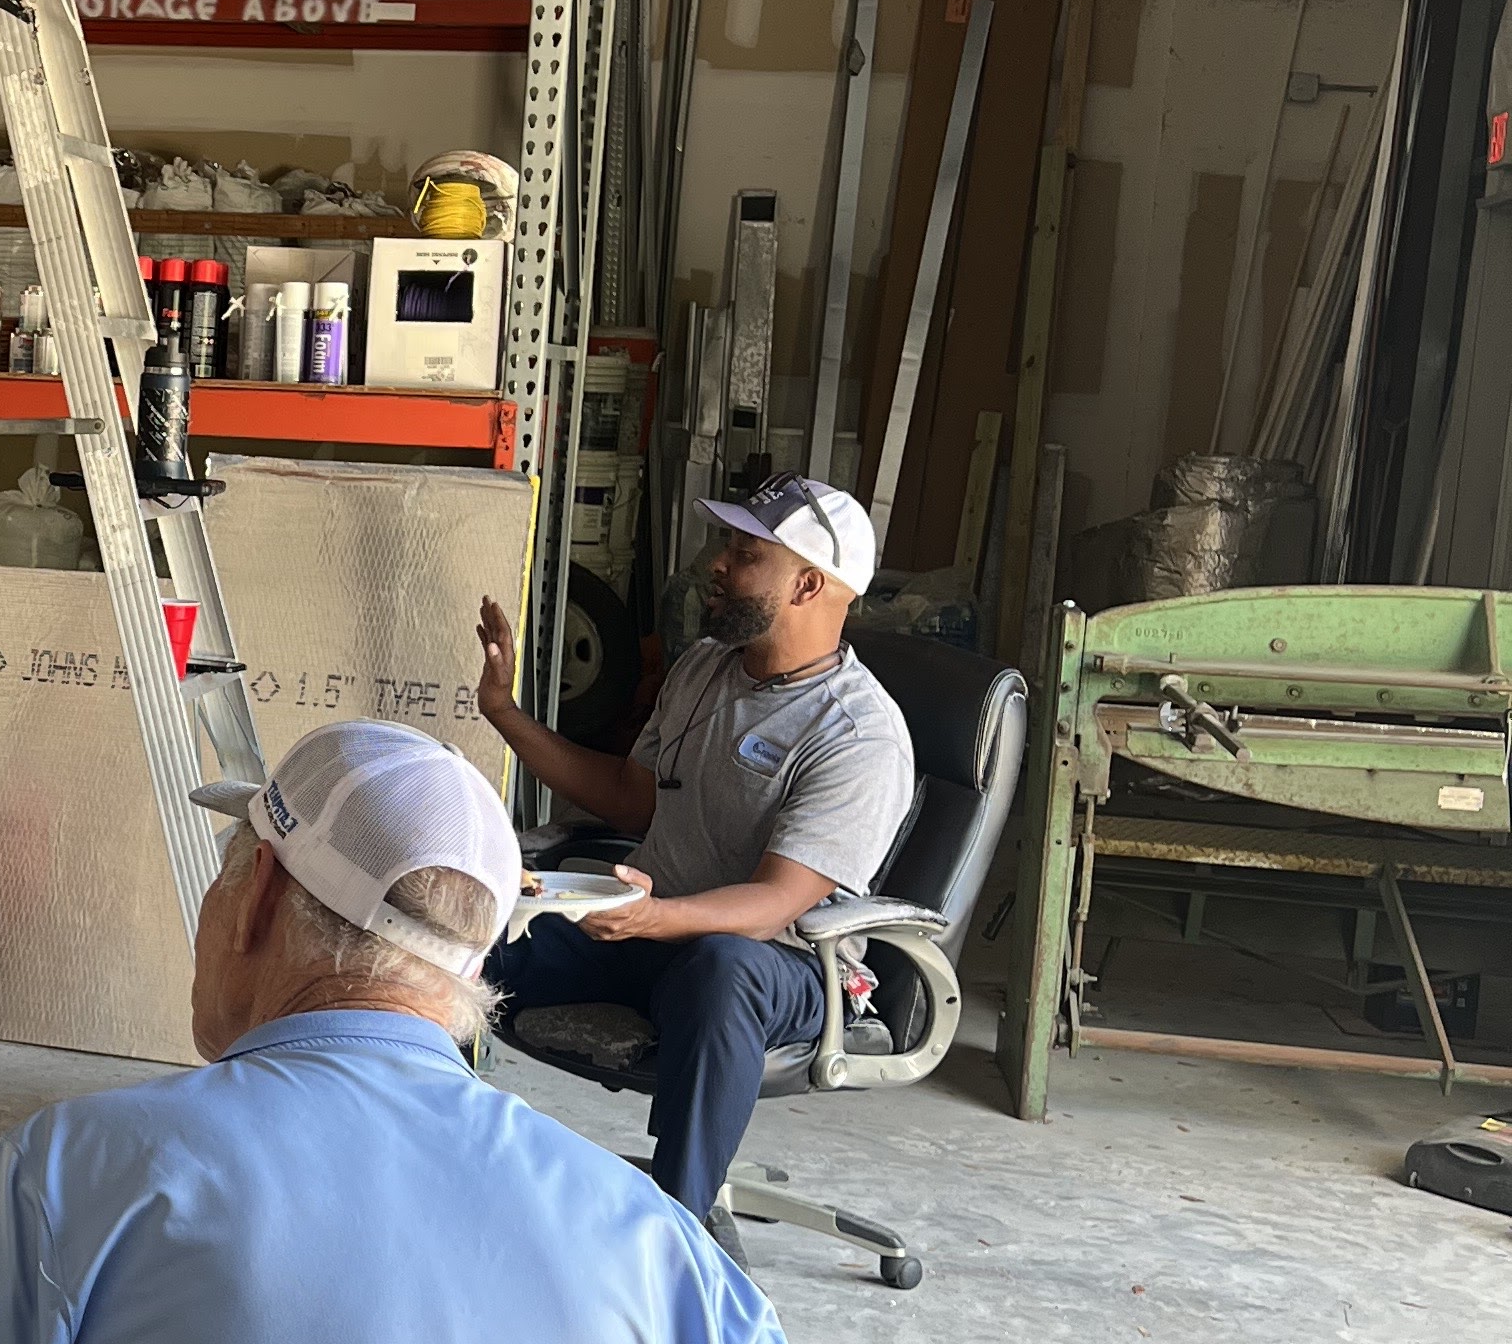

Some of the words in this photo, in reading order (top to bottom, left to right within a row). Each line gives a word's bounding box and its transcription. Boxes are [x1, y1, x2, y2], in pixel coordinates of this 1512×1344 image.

[22, 648, 97, 686] JOHNS
[296, 671, 355, 708] 1.5"
[375, 678, 440, 716] TYPE
